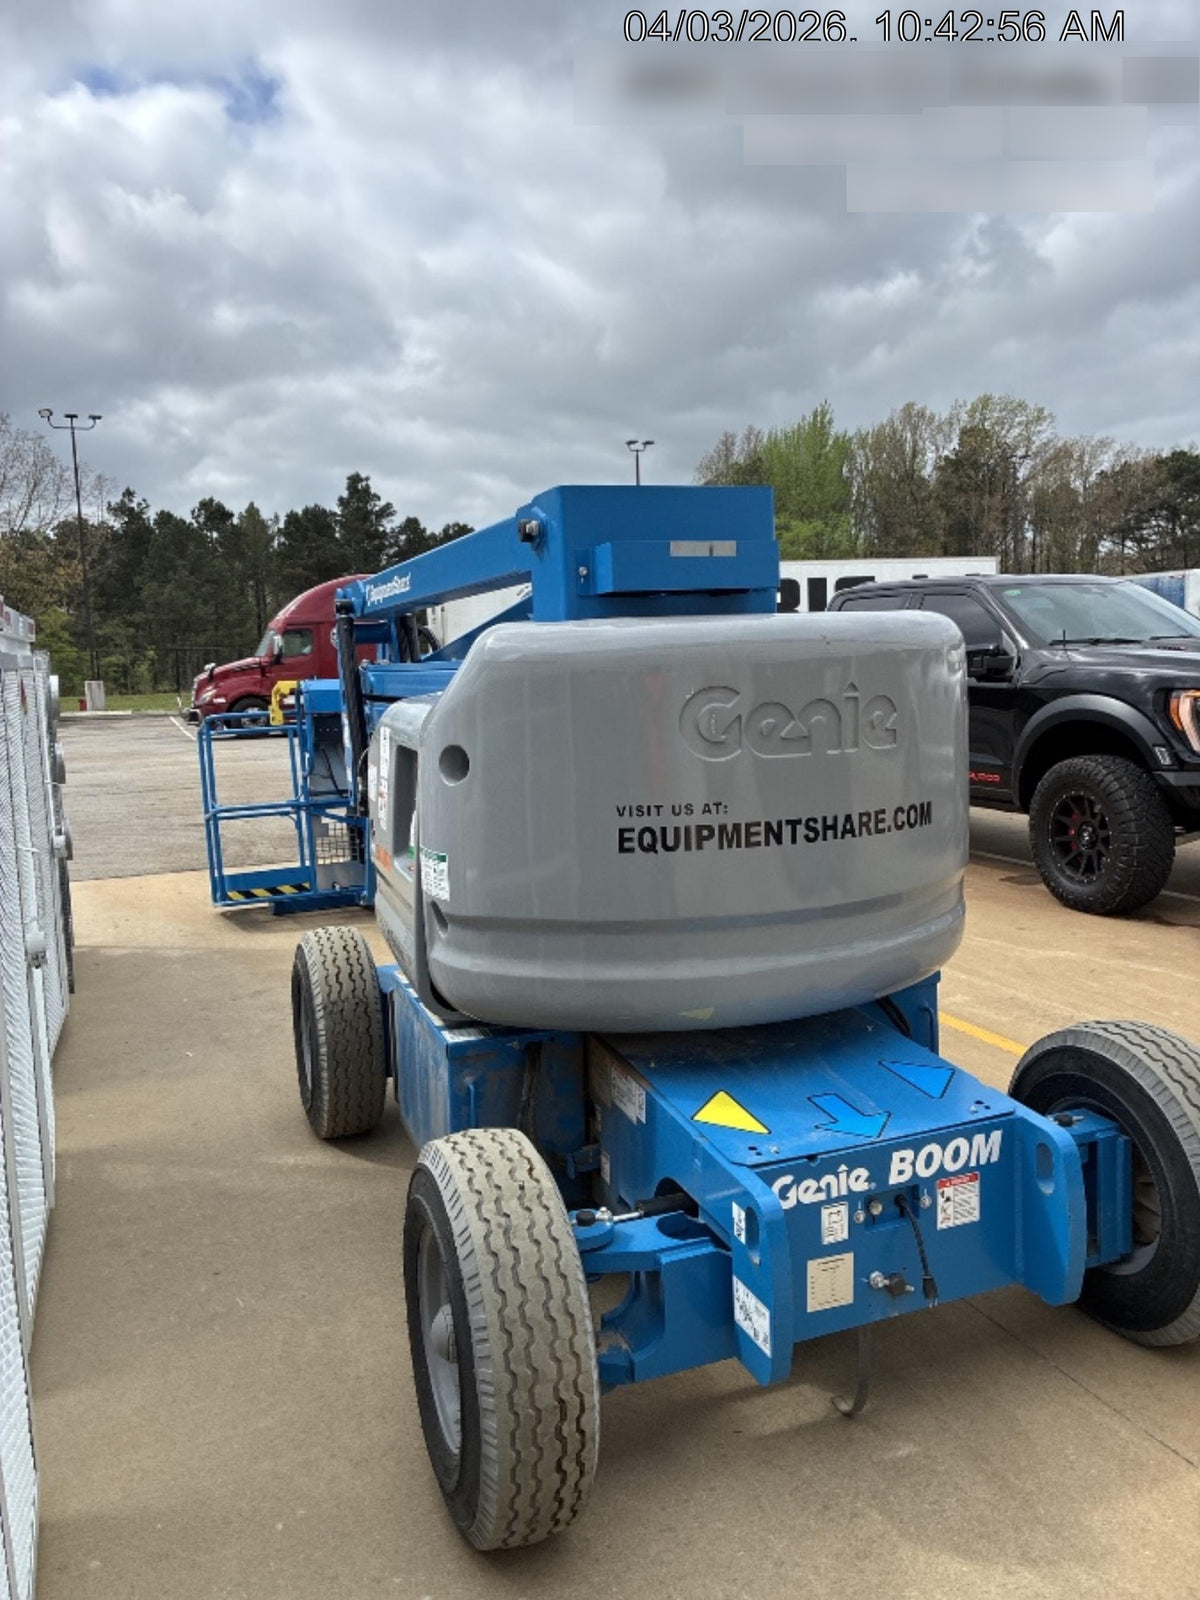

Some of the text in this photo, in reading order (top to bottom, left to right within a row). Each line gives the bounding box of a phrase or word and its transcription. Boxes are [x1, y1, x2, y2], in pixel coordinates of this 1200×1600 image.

[616, 801, 729, 817] VISIT US AT:
[618, 801, 933, 855] EQUIPMENTSHARE.COM
[889, 1129, 1003, 1186] BOOM
